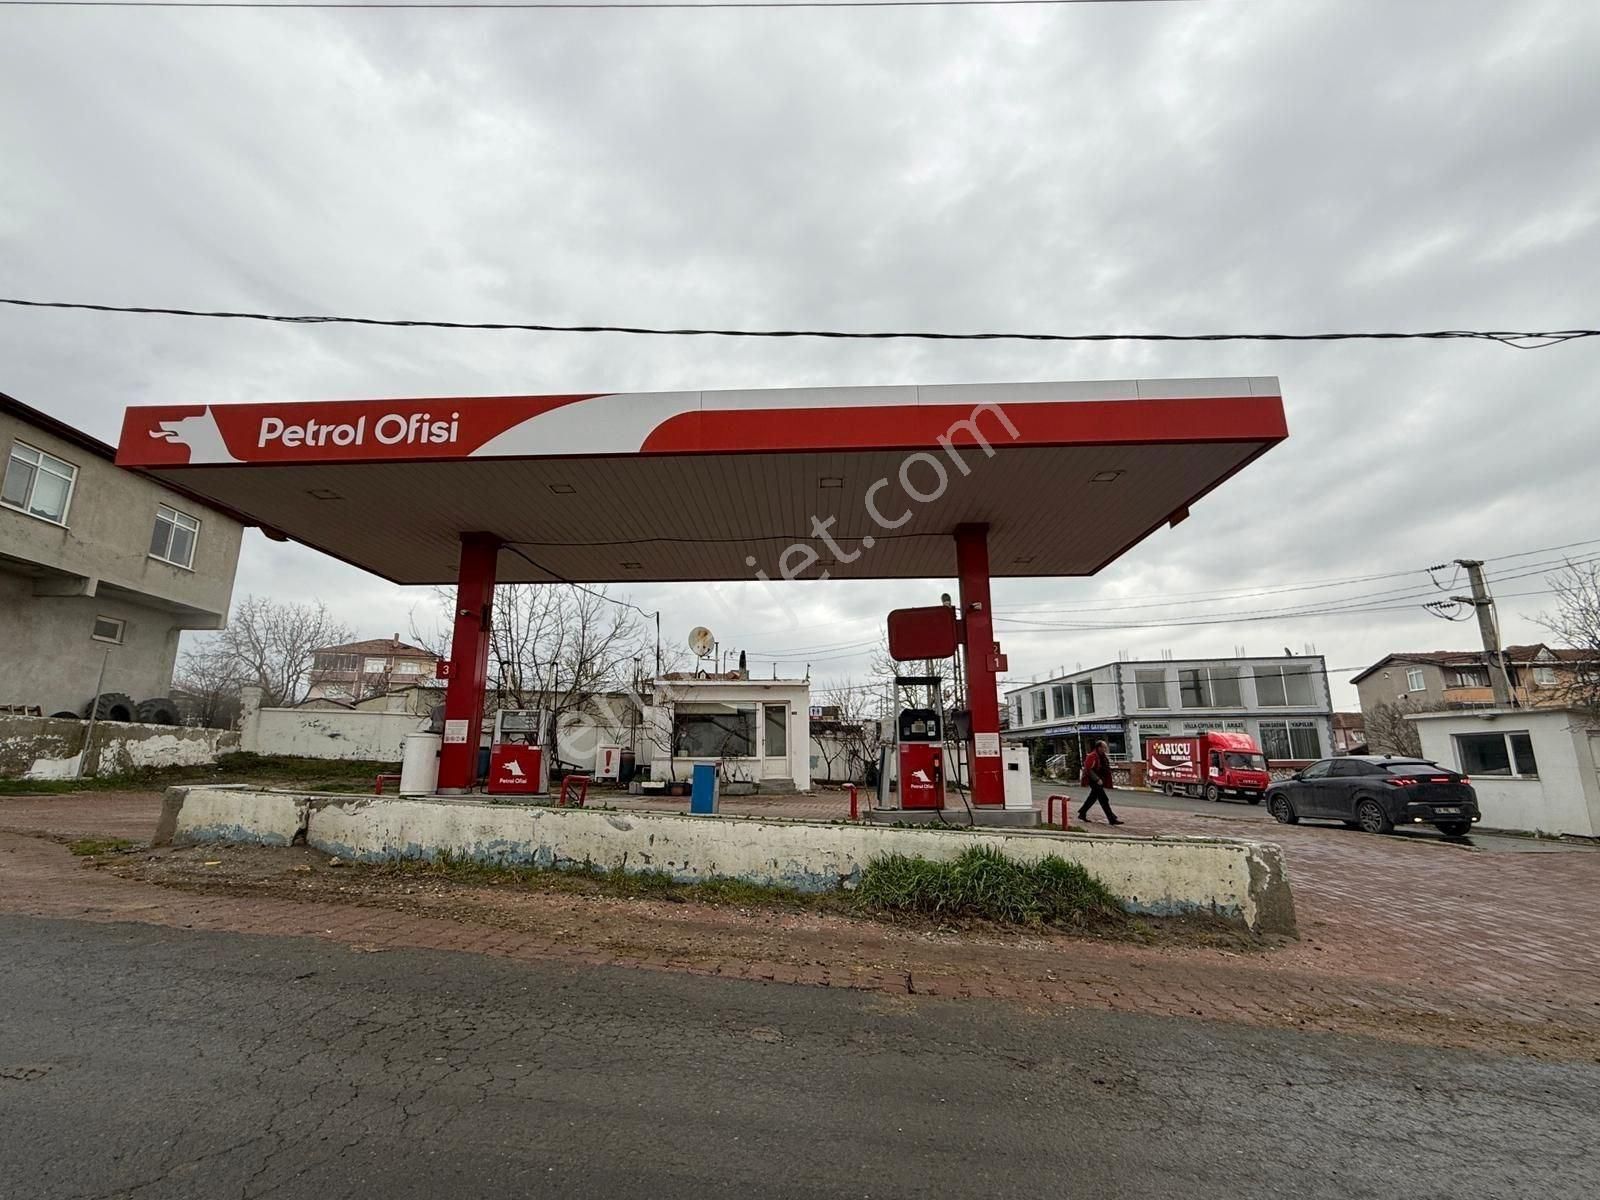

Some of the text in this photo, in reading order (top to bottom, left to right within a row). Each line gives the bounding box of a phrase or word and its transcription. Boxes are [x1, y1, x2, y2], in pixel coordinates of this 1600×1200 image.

[257, 412, 460, 448] Petrol Ofisi
[994, 658, 999, 668] 1
[442, 665, 450, 675] 3
[1159, 743, 1191, 755] ARUCU
